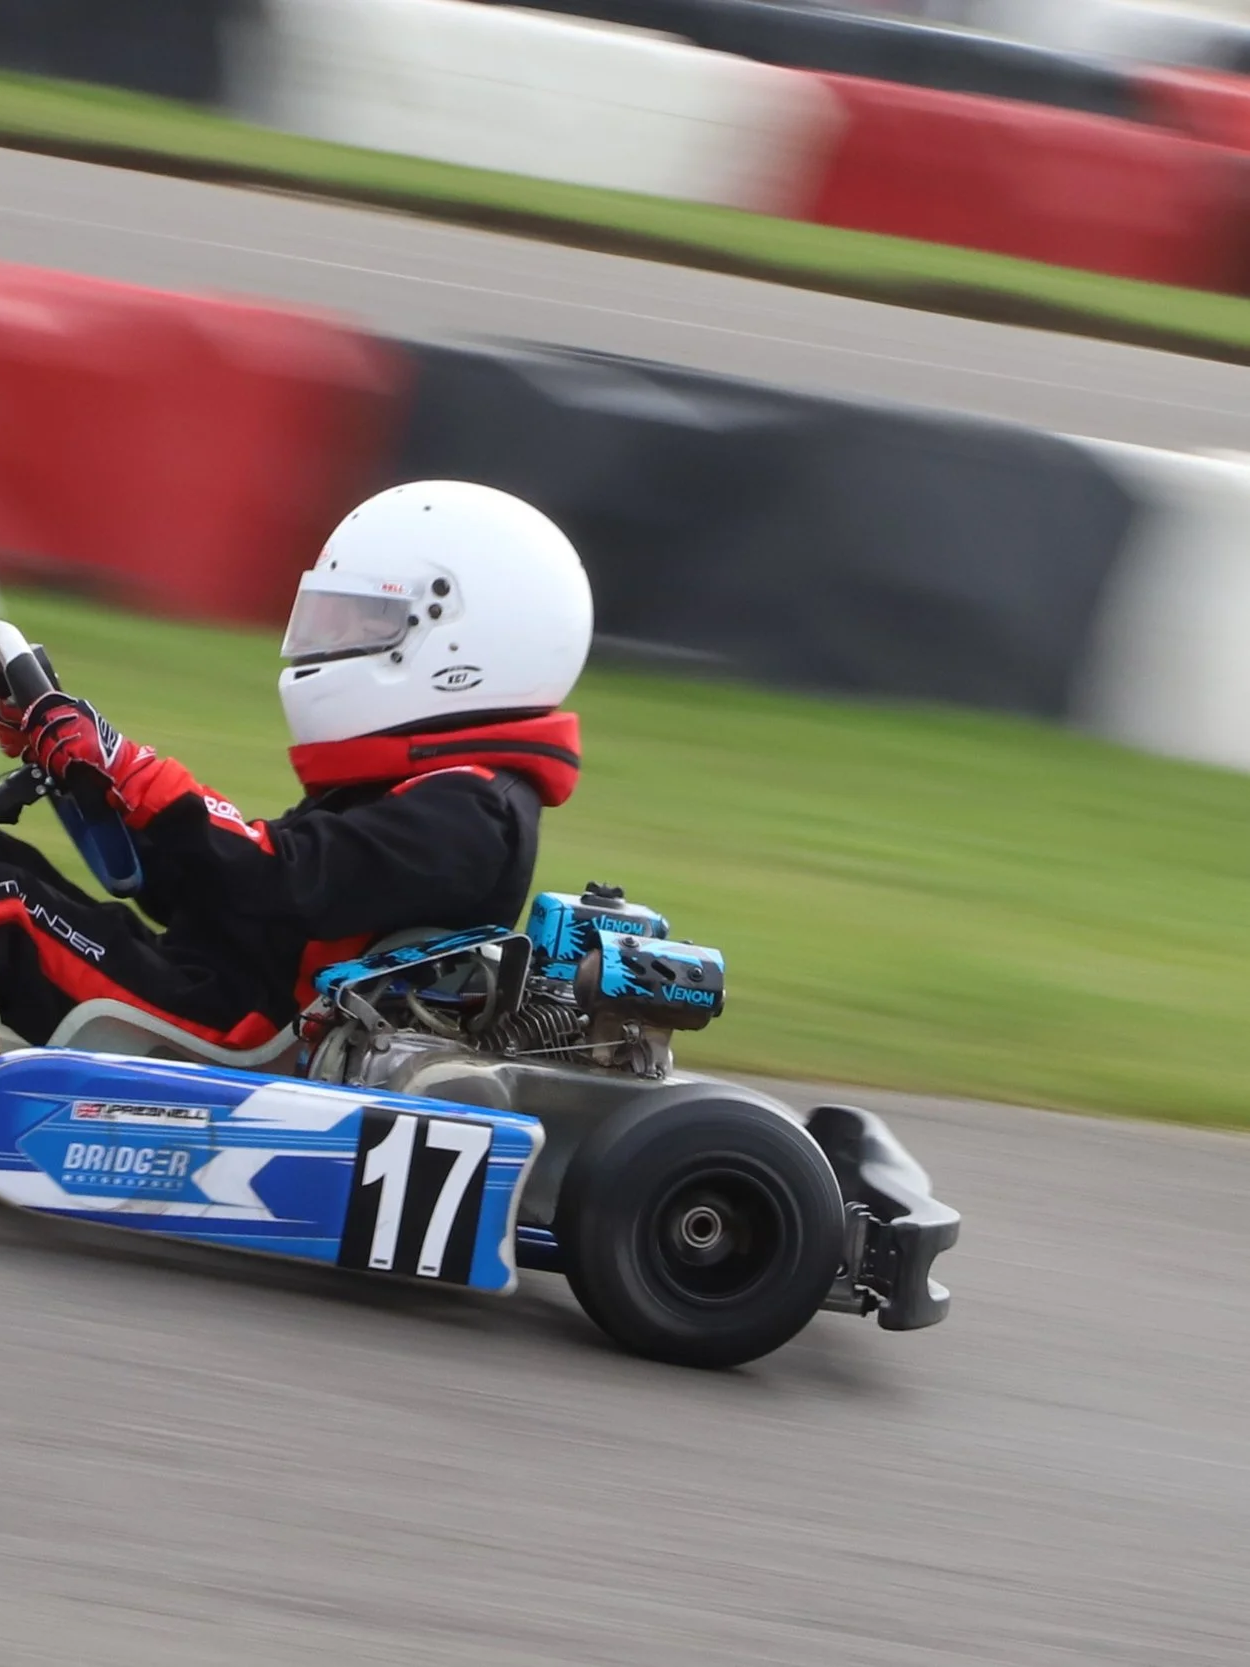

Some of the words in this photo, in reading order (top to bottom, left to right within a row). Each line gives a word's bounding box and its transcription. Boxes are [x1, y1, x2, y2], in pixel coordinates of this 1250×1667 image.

[592, 914, 645, 935] VENOM
[662, 983, 716, 1006] VENOM
[63, 1142, 191, 1177] BRIDGER
[361, 1114, 494, 1278] 17
